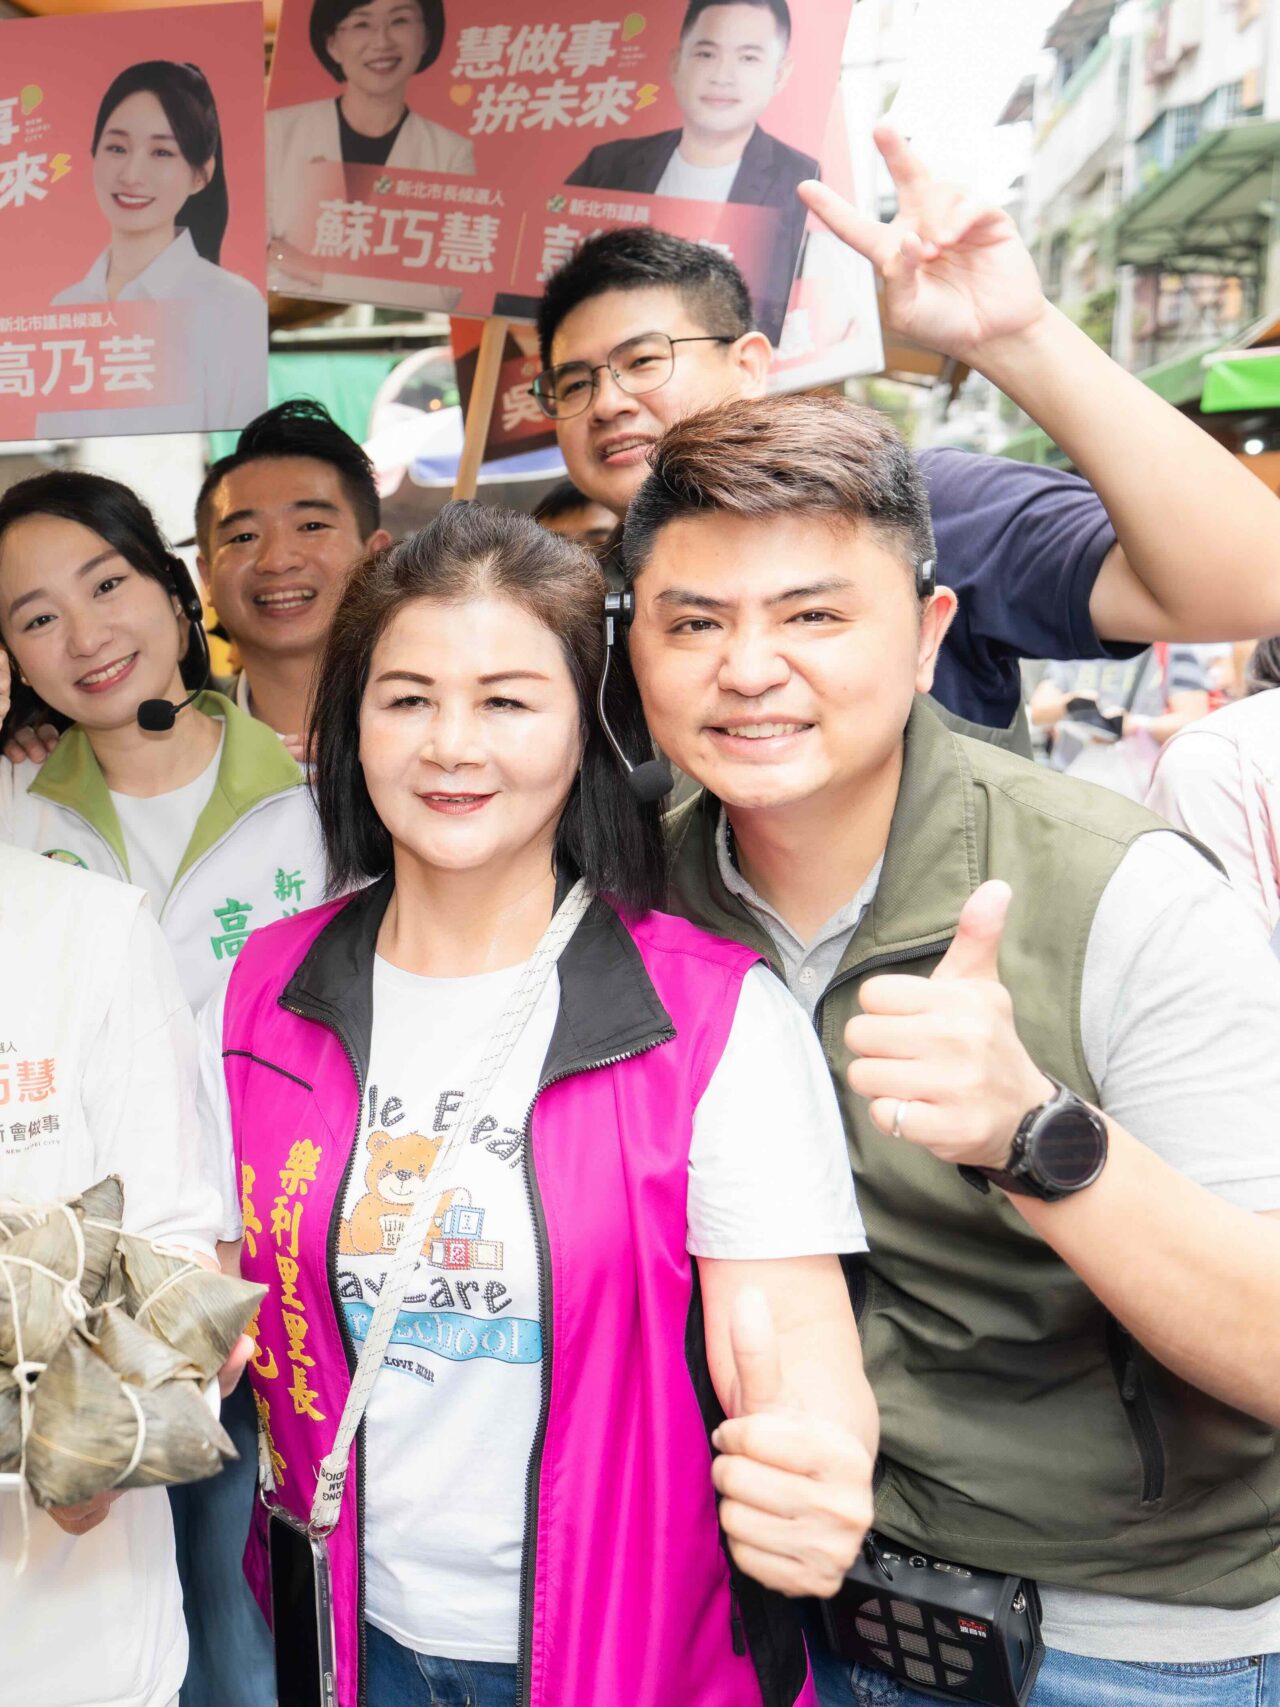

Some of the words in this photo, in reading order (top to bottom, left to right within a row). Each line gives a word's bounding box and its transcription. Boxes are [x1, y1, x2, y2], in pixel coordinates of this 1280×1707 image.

[450, 20, 620, 79] 慧做事
[395, 180, 505, 207] 新北市長候選人
[310, 198, 501, 274] 蘇巧慧
[210, 897, 253, 960] 高
[9, 1114, 60, 1142] 會做事
[269, 1138, 327, 1421] 樂利里里長
